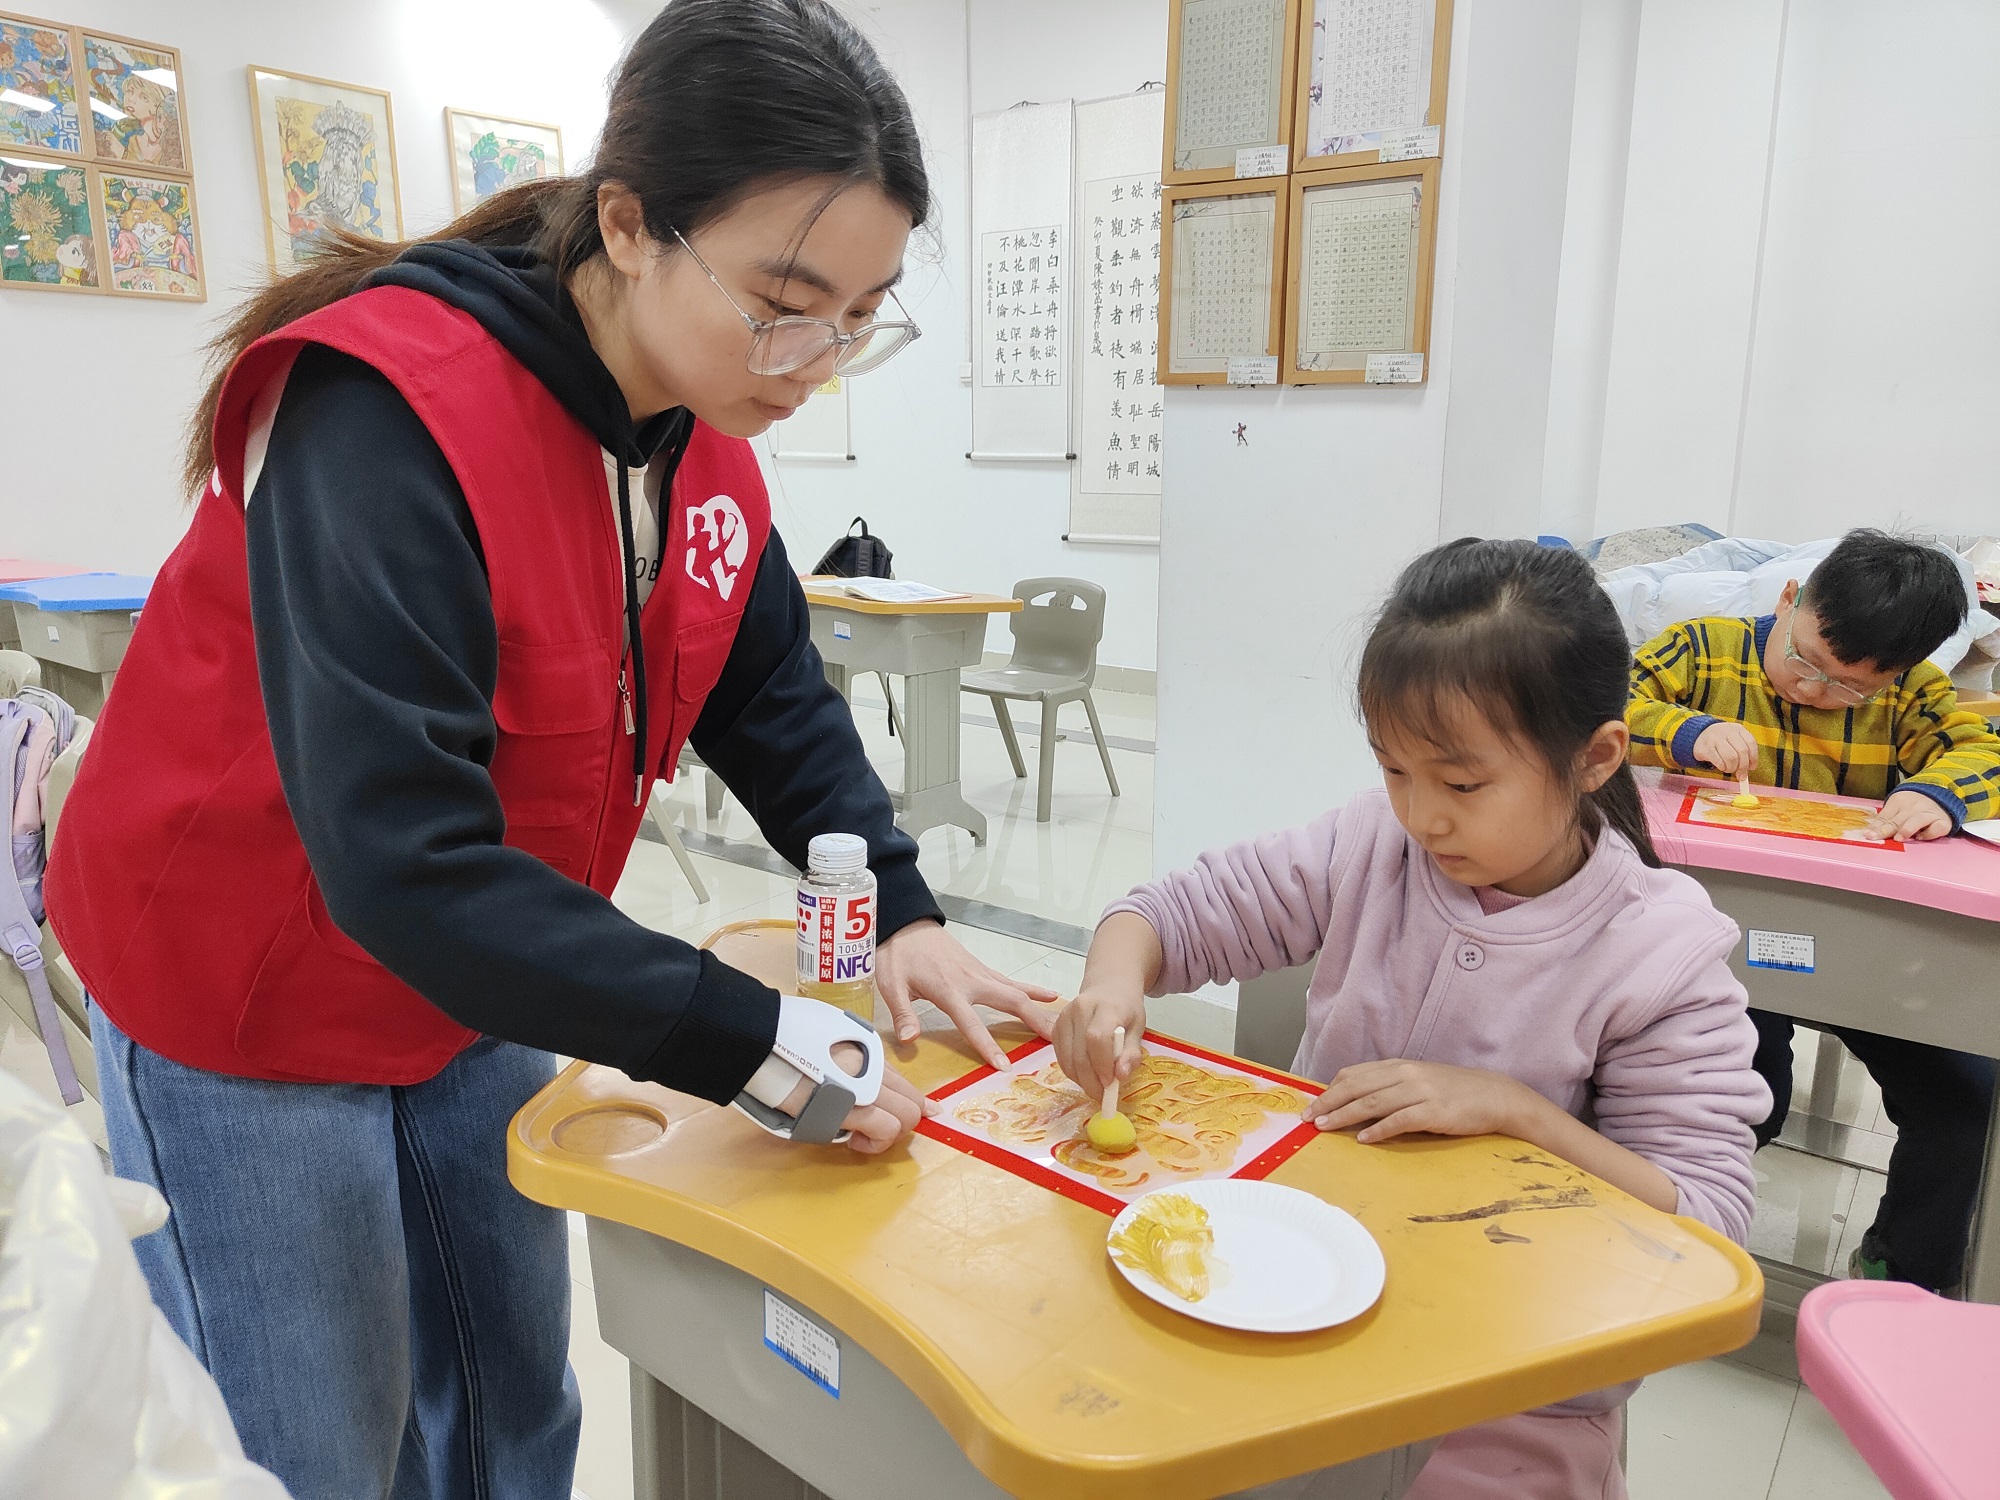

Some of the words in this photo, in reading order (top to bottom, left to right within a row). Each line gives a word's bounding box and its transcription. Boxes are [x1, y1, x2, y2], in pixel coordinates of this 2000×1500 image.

[821, 915, 833, 979] 非浓缩还原
[837, 951, 871, 979] NFC
